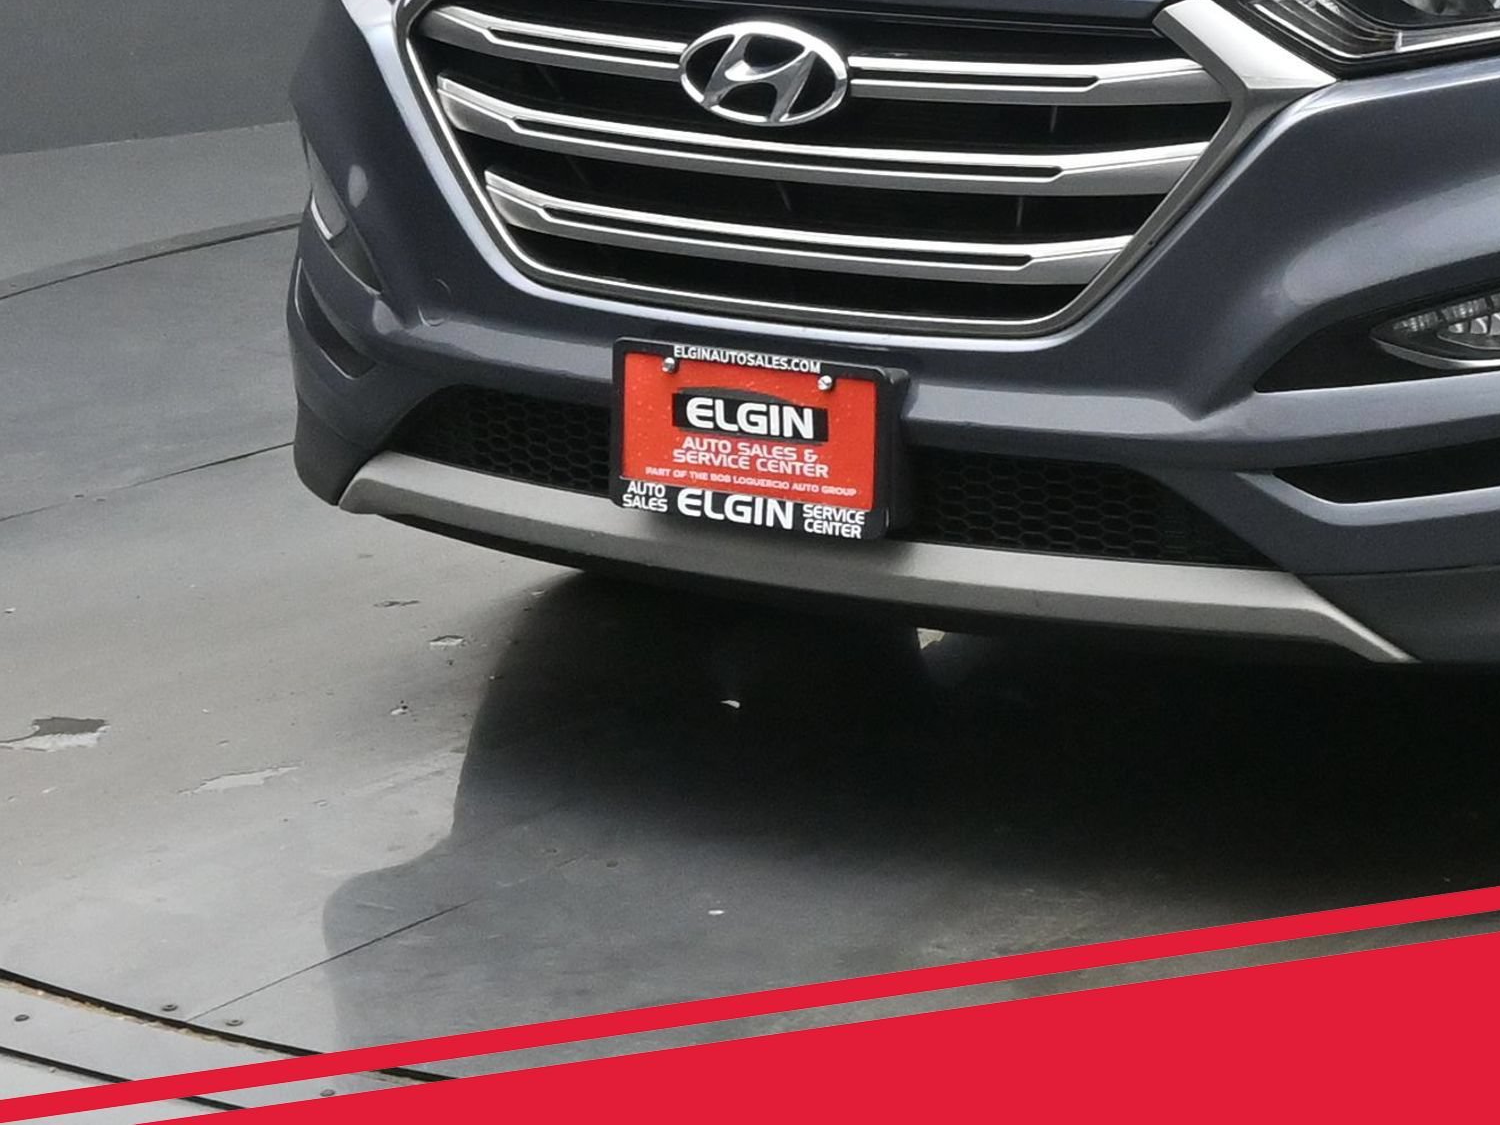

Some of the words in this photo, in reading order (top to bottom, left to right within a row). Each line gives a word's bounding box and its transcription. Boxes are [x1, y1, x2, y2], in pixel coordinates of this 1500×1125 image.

[673, 345, 821, 374] ELGINAUTOSALES.COM
[685, 397, 814, 439] ELGIN
[672, 449, 750, 470] SERVICE
[755, 458, 829, 478] CENTER
[682, 436, 732, 454] AUTO
[737, 442, 797, 461] SALES
[803, 448, 818, 463] &
[627, 481, 666, 498] AUTO
[645, 466, 671, 477] PART
[672, 469, 688, 478] OF
[689, 471, 708, 481] THE
[791, 483, 820, 493] AUTO
[821, 485, 857, 496] GROUP
[622, 493, 668, 513] SALES
[677, 487, 794, 530] ELGIN
[802, 504, 865, 525] SERVICE
[803, 519, 862, 539] CENTER
